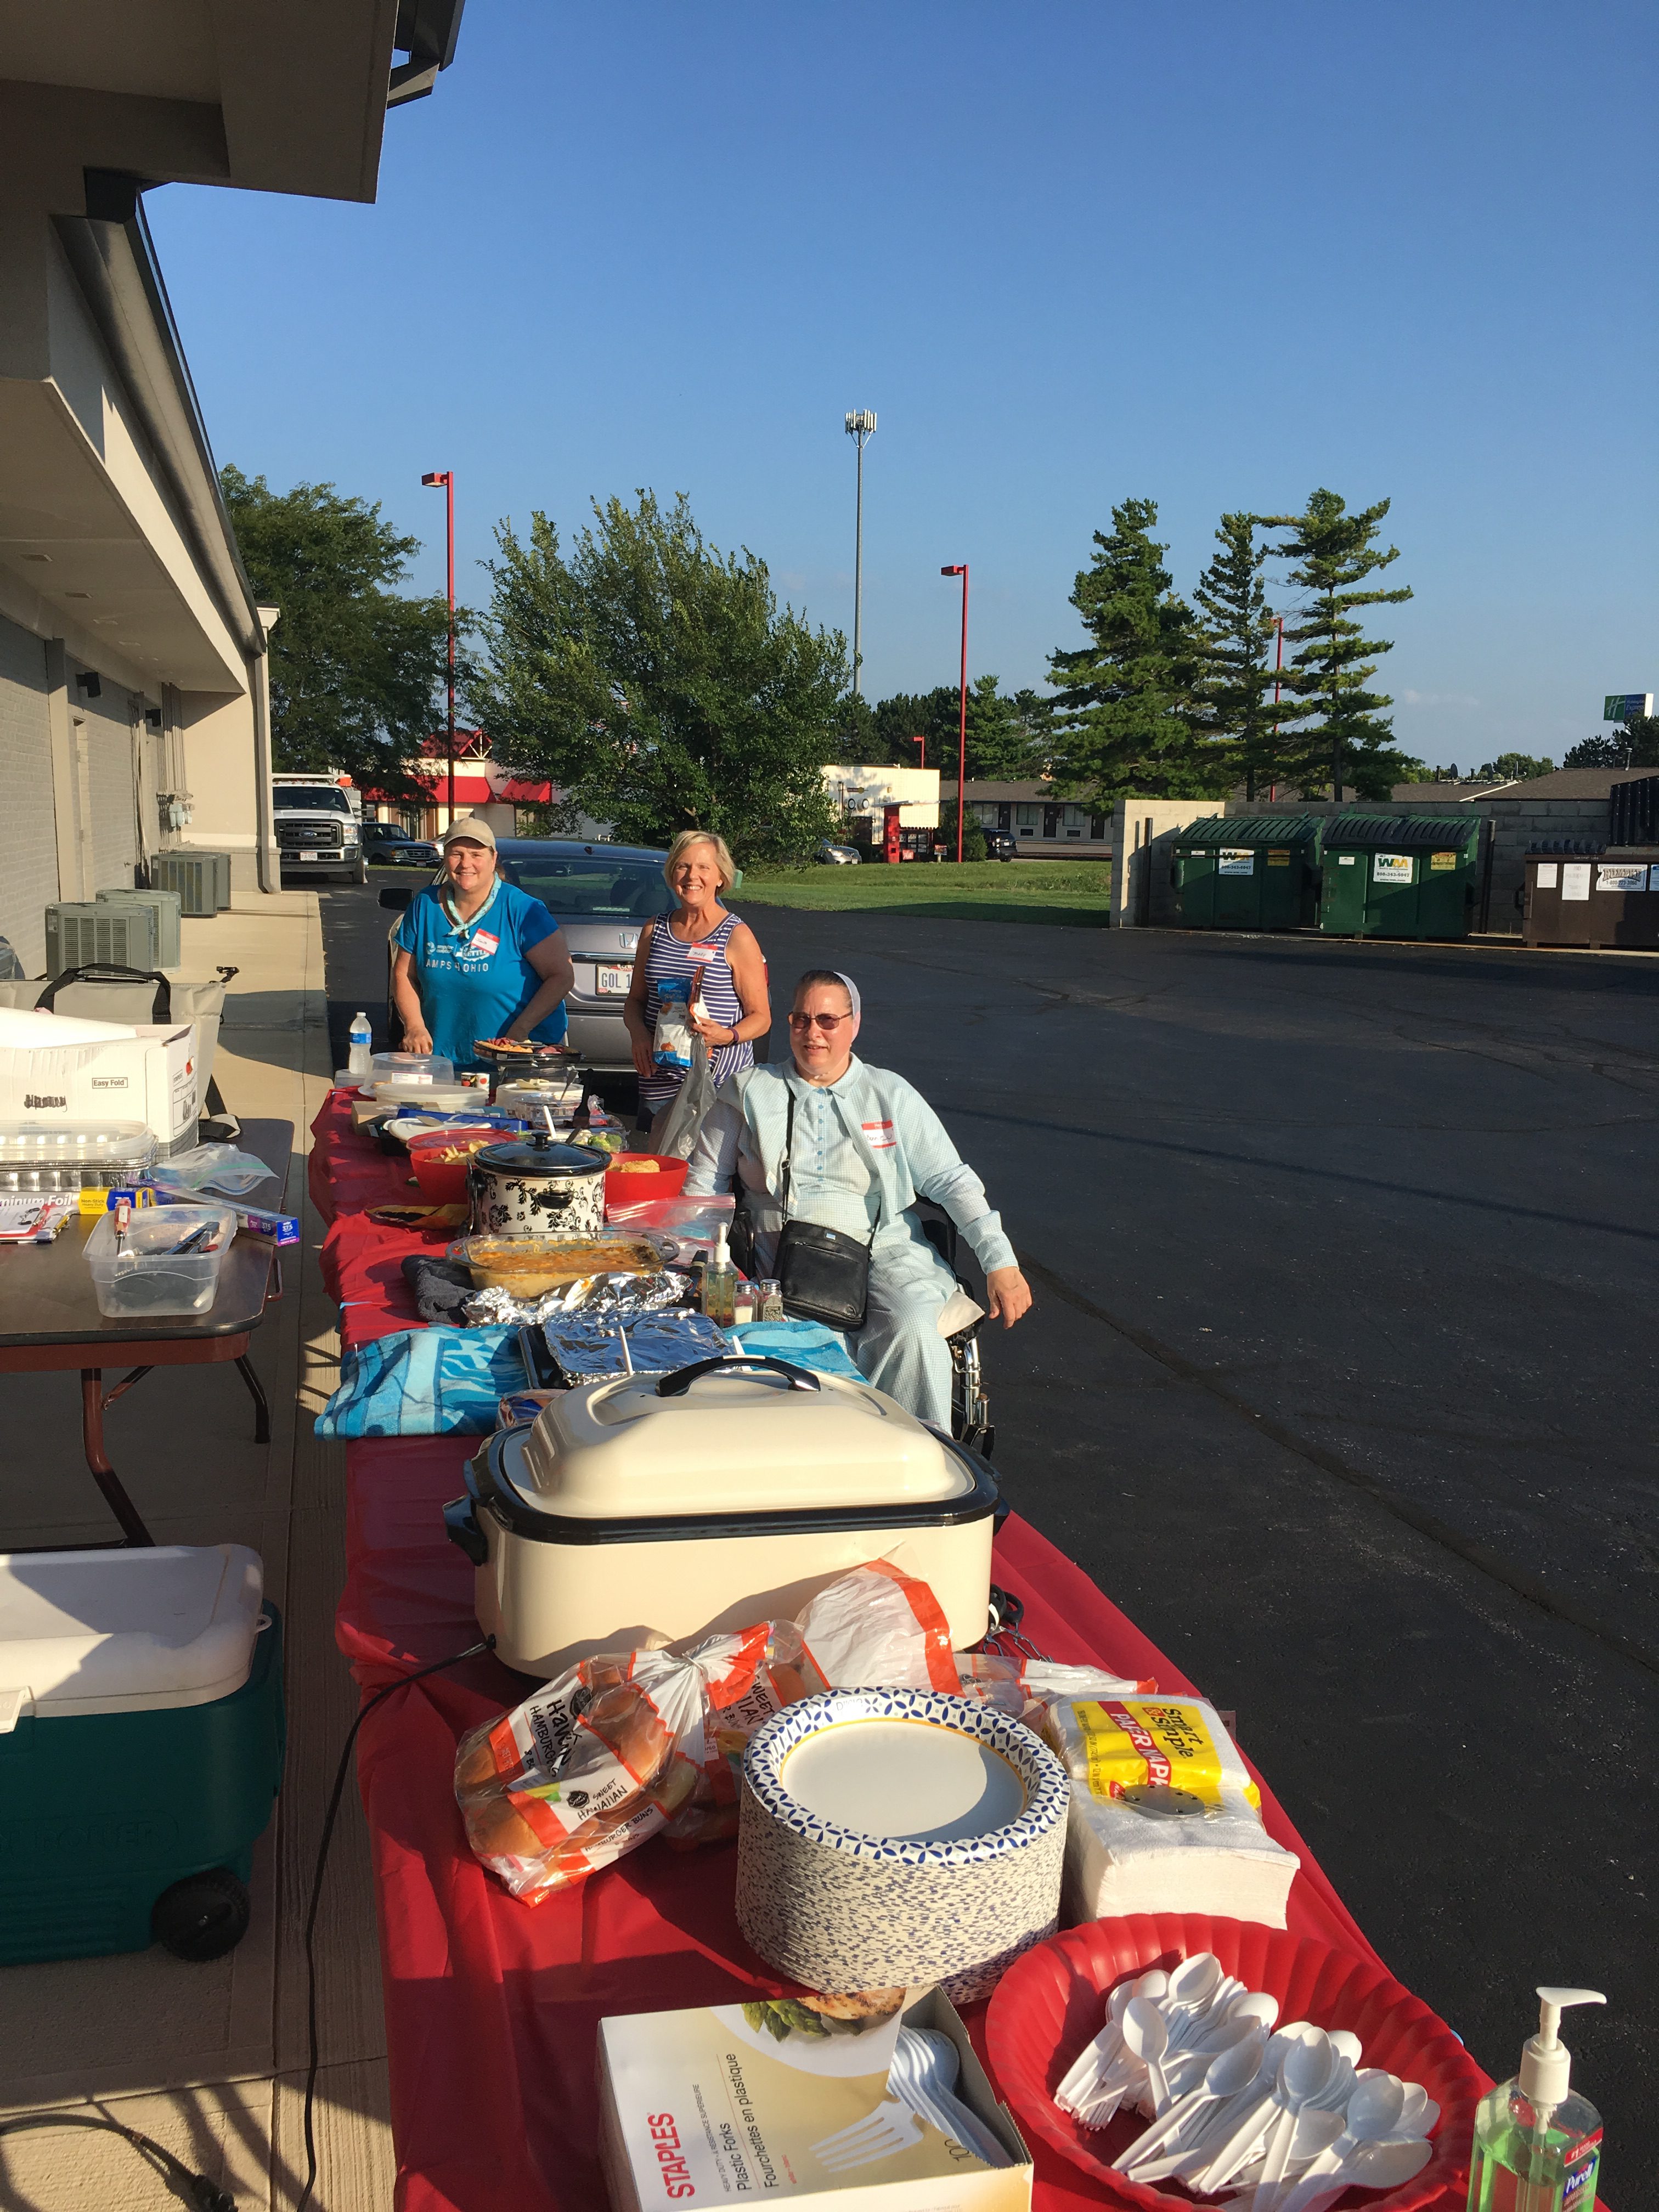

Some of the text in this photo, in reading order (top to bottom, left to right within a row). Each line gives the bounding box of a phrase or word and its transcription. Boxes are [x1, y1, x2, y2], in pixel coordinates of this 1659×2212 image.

[1378, 858, 1408, 868] WM
[463, 963, 489, 973] OHIO
[601, 973, 622, 988] GOL
[48, 1195, 72, 1206] Foil
[1151, 1717, 1194, 1758] Simple
[1162, 1708, 1204, 1745] Smart
[577, 1785, 628, 1820] HAWAIIAN
[592, 1778, 617, 1801] SWEET
[631, 1807, 653, 1825] BUNS
[726, 2053, 780, 2188] Fourchettes en plastique
[647, 2113, 695, 2199] STAPLES
[719, 2123, 752, 2192] Plastic Forks
[721, 2172, 731, 2193] HEAVY
[1566, 2161, 1593, 2194] Purell
